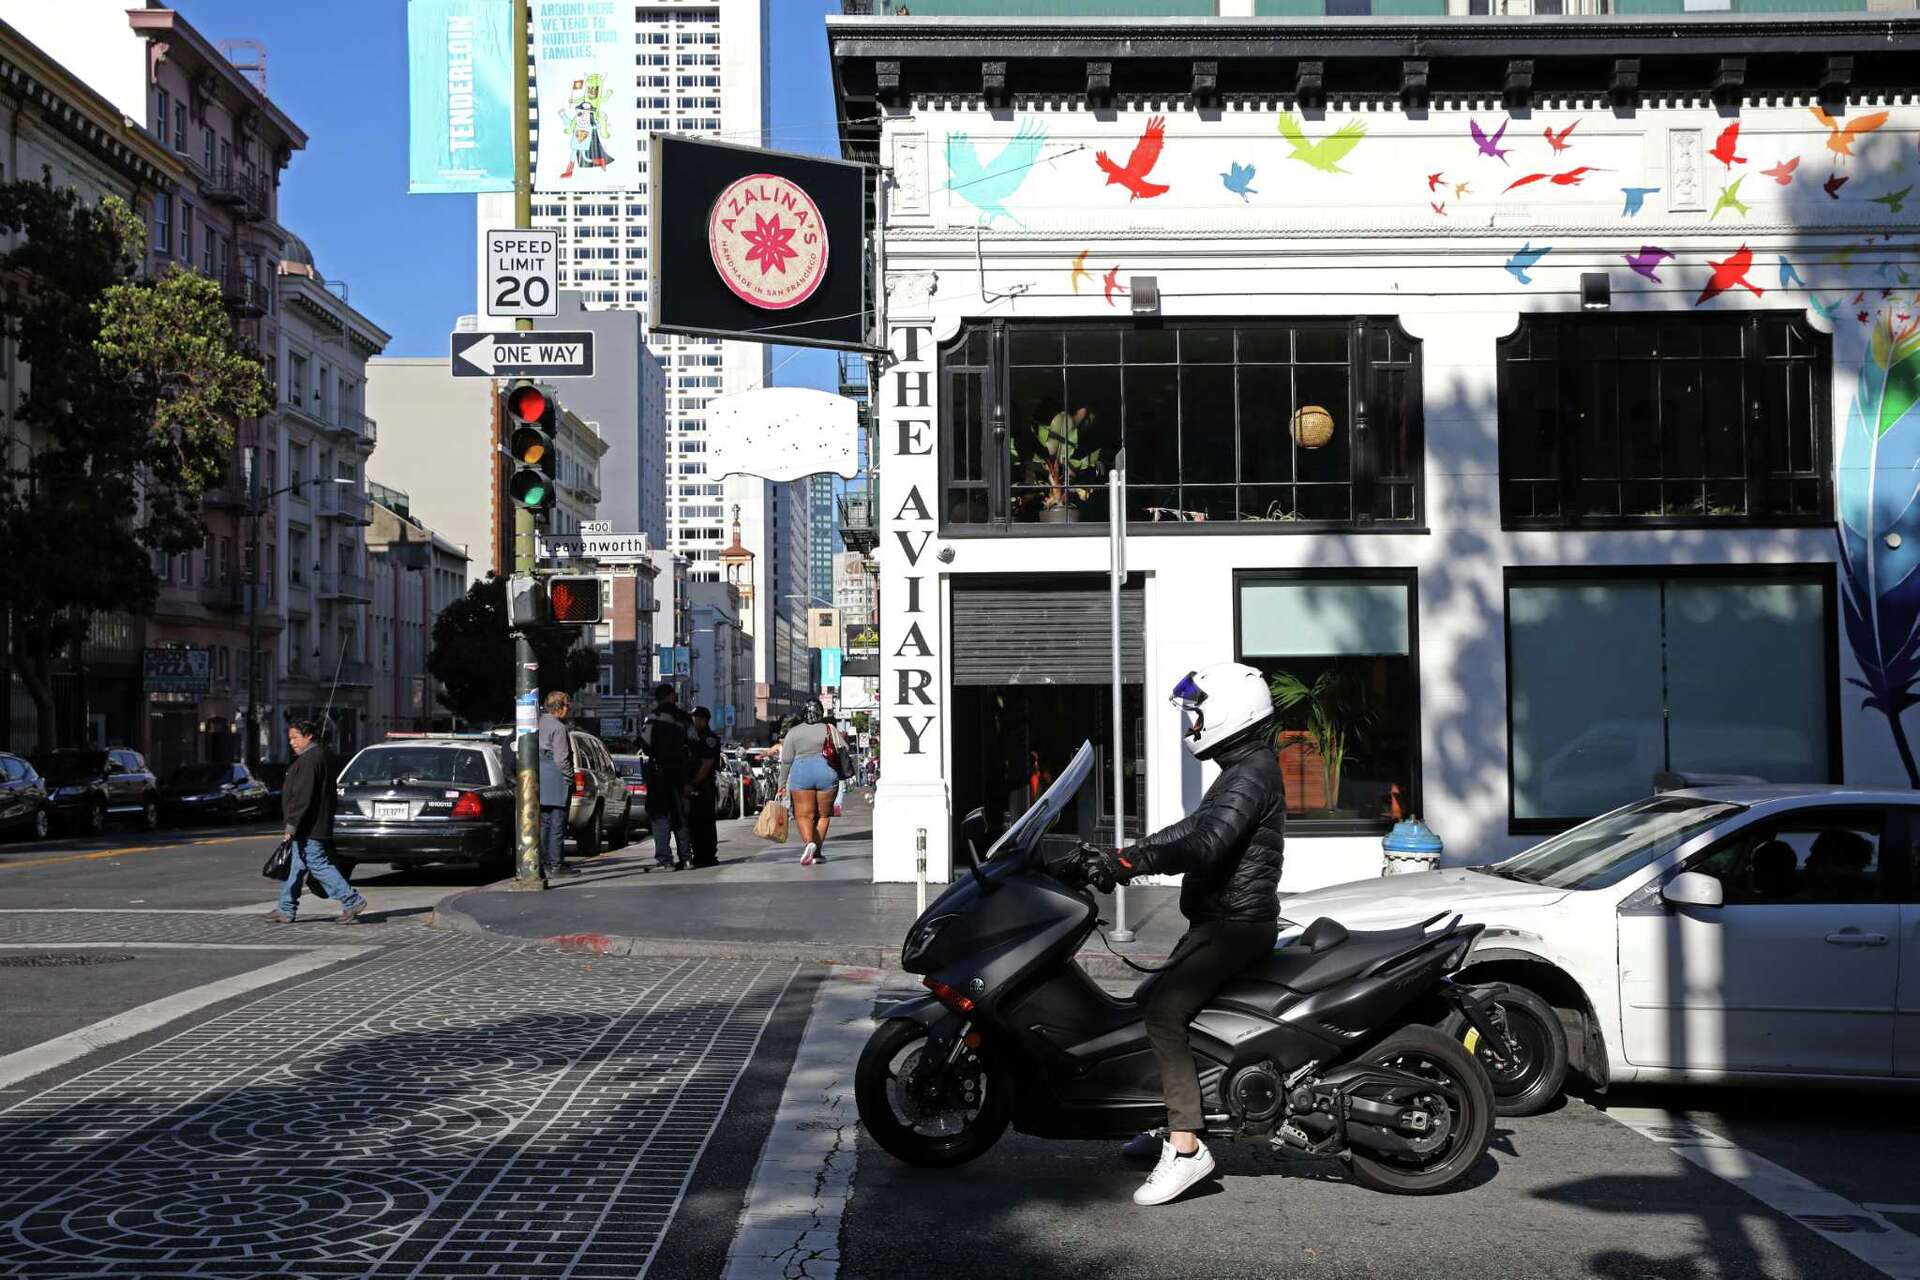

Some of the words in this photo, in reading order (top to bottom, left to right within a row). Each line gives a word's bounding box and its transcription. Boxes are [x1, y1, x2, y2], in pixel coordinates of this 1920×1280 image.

[541, 3, 584, 16] AROUND
[587, 2, 615, 15] HERE
[541, 18, 558, 31] WE
[560, 17, 588, 30] TEND
[593, 16, 606, 28] TO
[542, 32, 592, 45] NURTURE
[594, 31, 617, 43] OUR
[543, 45, 597, 60] FAMILIES.
[448, 16, 476, 152] TENDERLOIN
[721, 185, 817, 245] AZALINA'S
[493, 240, 552, 253] SPEED
[500, 258, 545, 271] LIMIT
[722, 240, 752, 288] HANDMADE
[754, 286, 763, 294] IN
[767, 288, 784, 297] SAN
[786, 253, 816, 293] FRANCISCO
[495, 276, 550, 307] 20
[494, 346, 532, 363] ONE
[539, 346, 577, 363] WAY
[891, 326, 933, 456] THE
[588, 523, 609, 532] 400
[545, 539, 642, 552] Leavenworth
[892, 484, 936, 754] AVIARY
